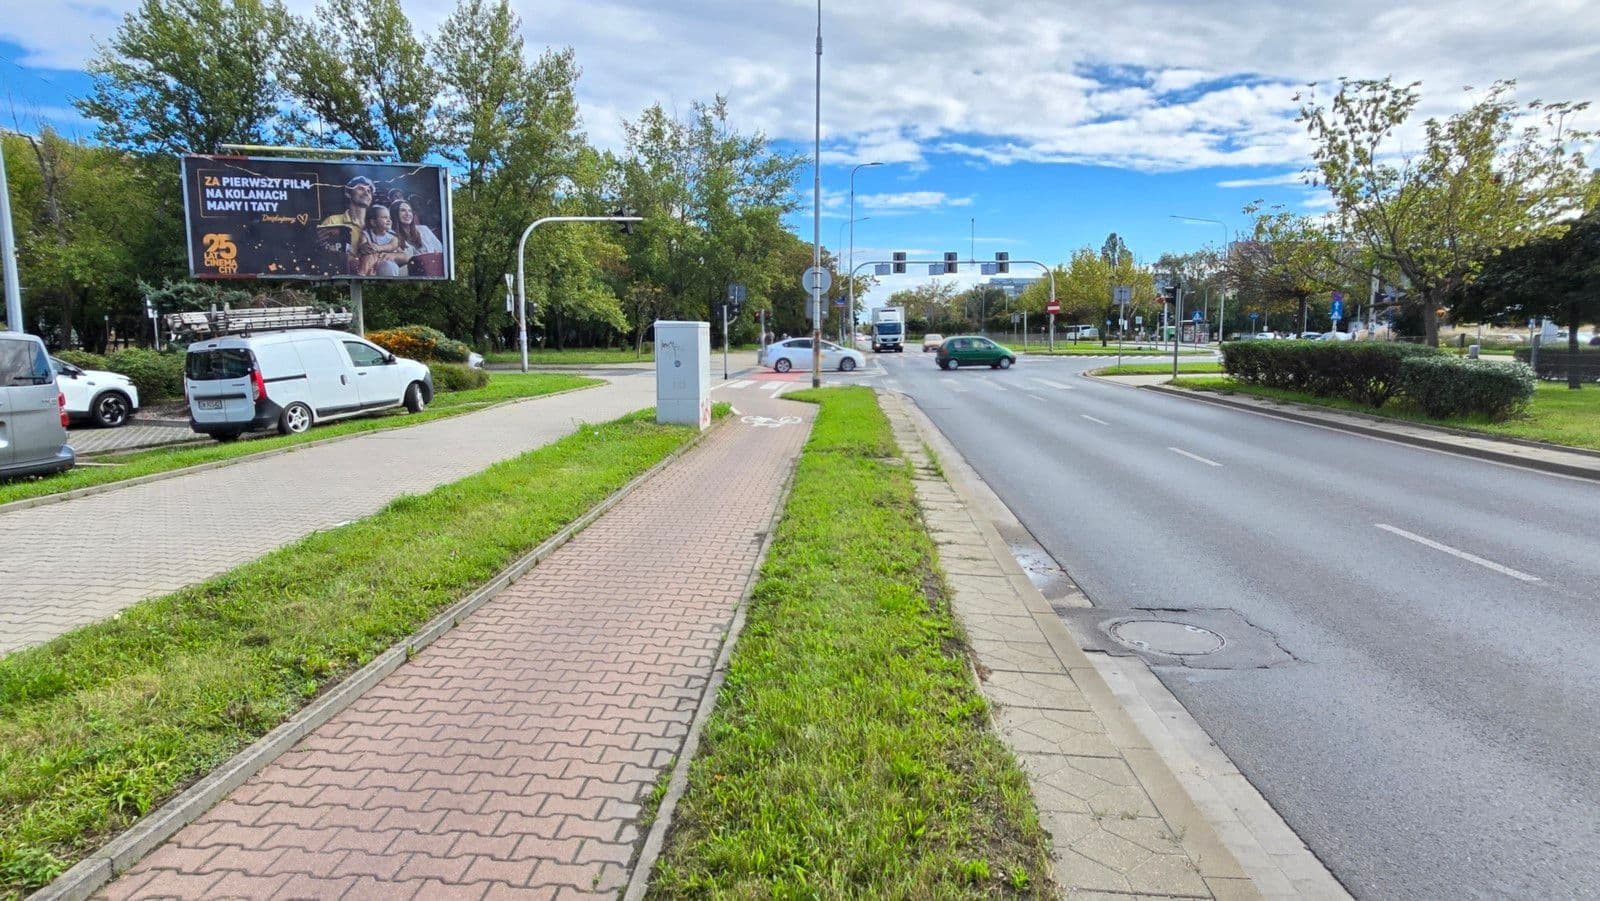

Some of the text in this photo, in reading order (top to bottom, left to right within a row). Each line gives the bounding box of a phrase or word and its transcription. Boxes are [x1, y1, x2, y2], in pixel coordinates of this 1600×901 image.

[204, 176, 311, 190] ZA PIERWSZY FILM
[205, 188, 288, 200] NA KOLANACH
[206, 201, 279, 212] MAMY I TATY
[202, 233, 237, 259] 25
[204, 258, 238, 268] CINEMA
[219, 265, 238, 274] CITY
